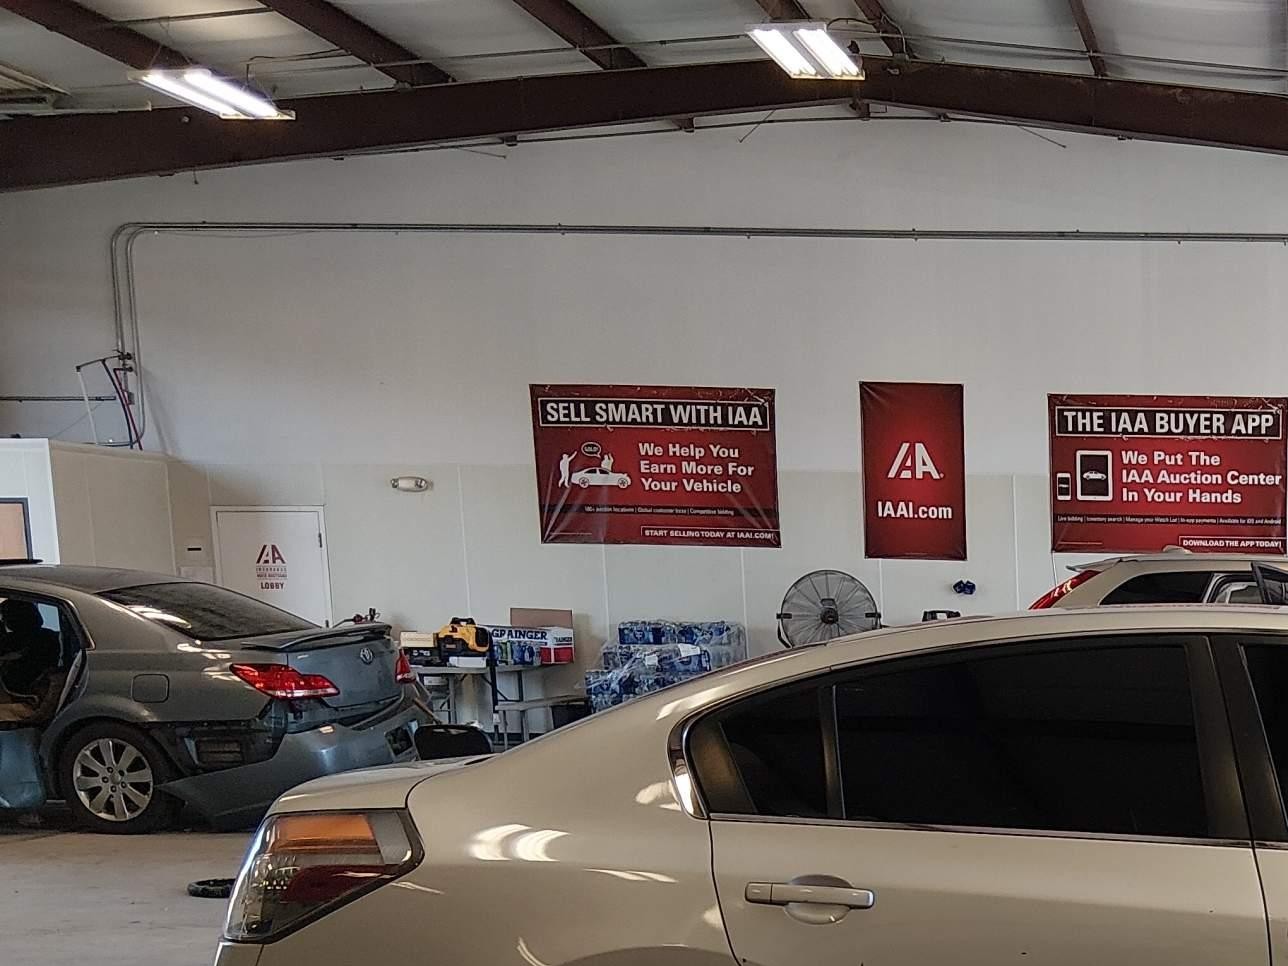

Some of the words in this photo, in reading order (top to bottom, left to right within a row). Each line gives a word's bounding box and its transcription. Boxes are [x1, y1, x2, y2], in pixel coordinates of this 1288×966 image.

[547, 402, 590, 422] SELL
[596, 403, 665, 424] SMART
[669, 404, 722, 425] WITH
[728, 406, 763, 426] IAA
[1064, 411, 1104, 432] THE
[1111, 412, 1148, 433] IAA
[1155, 412, 1225, 434] BUYER
[1231, 414, 1274, 436] APP
[639, 442, 663, 457] We
[668, 443, 705, 459] Help
[709, 444, 739, 458] You
[1122, 450, 1147, 465] We
[1153, 451, 1183, 466] Put
[1188, 451, 1220, 466] The
[640, 460, 676, 474] Earn
[682, 462, 723, 475] More
[728, 462, 754, 476] For
[641, 478, 677, 491] Your
[682, 478, 741, 493] Vehicle
[1122, 470, 1152, 483] IAA
[1156, 470, 1221, 484] Auction
[1227, 471, 1281, 486] Center
[1122, 488, 1138, 502] In
[1143, 489, 1182, 503] Your
[1188, 489, 1242, 504] Hands
[877, 501, 952, 519] IAAI.com
[670, 530, 700, 538] SELLING
[1182, 539, 1225, 547] DOWNLOAD
